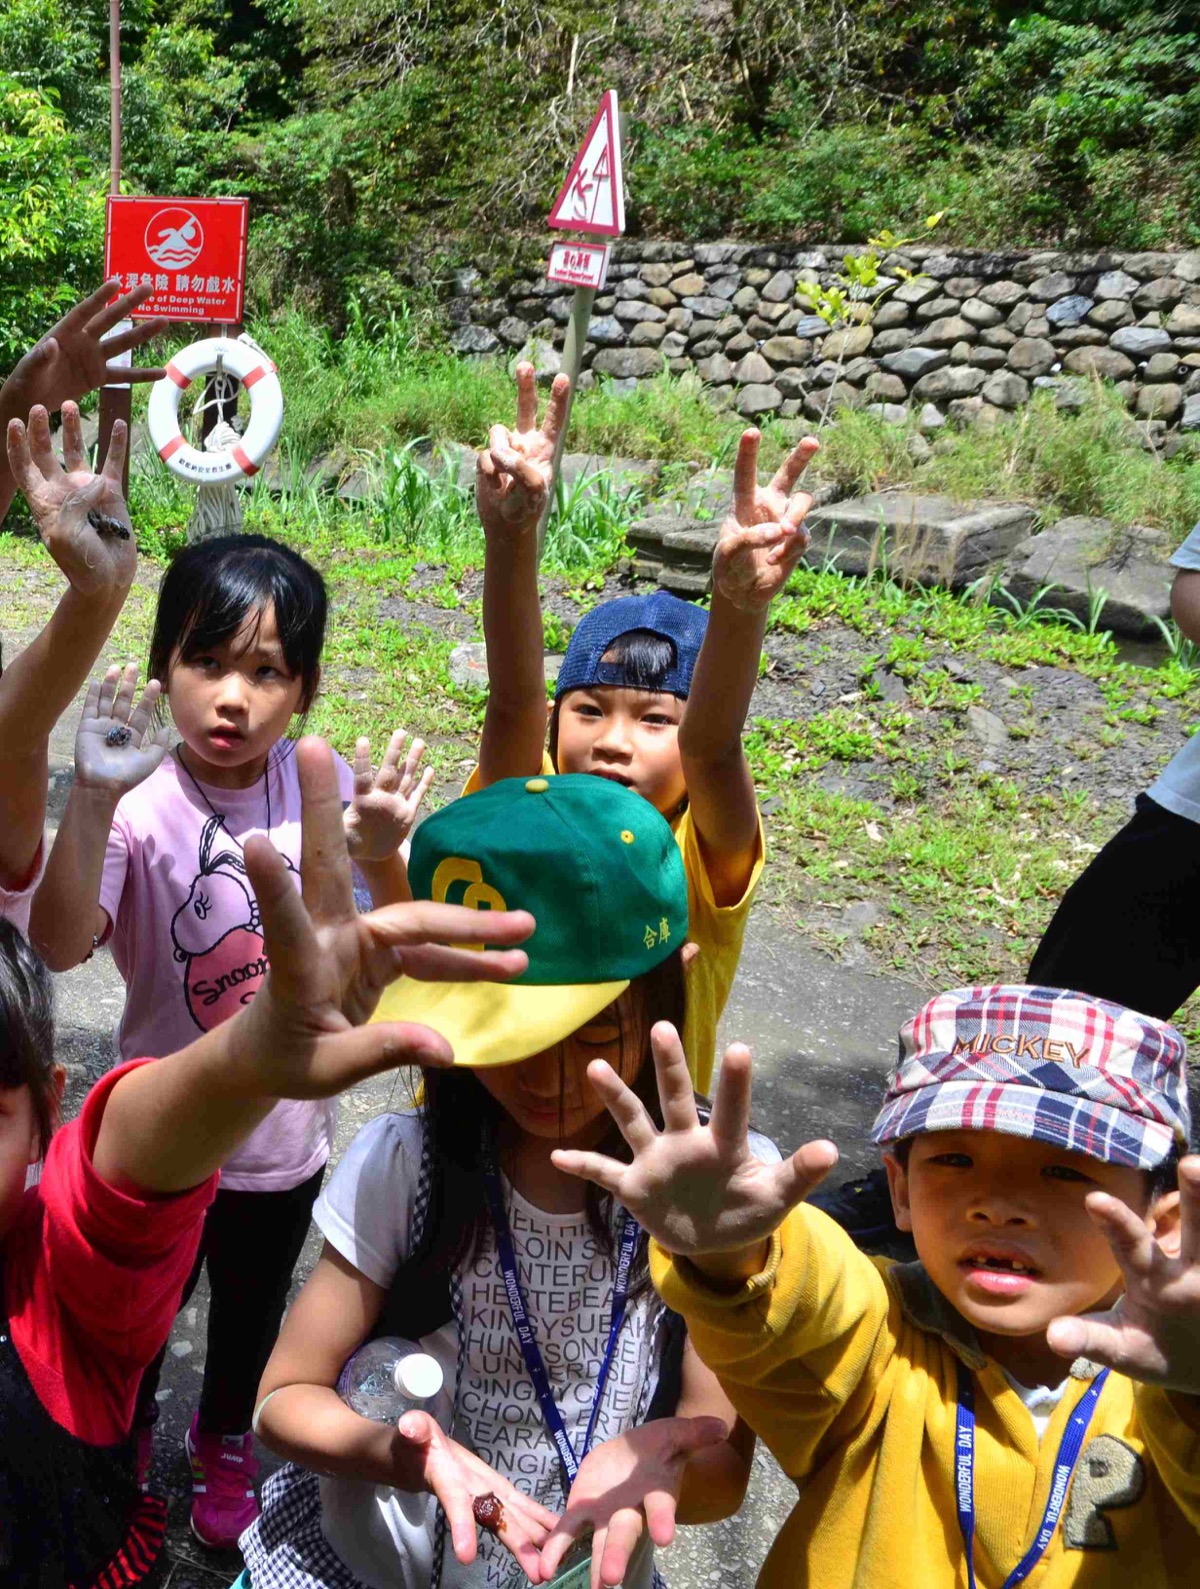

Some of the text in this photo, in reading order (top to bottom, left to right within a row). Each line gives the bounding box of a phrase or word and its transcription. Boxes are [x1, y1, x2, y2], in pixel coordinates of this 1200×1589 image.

[153, 304, 205, 316] Swimming
[155, 295, 168, 303] of
[169, 295, 195, 305] Deep
[197, 296, 227, 306] Water
[643, 917, 671, 949] 合庫
[951, 1032, 1090, 1069] MICKEY
[616, 1241, 634, 1293] WONDERFUL
[504, 1269, 534, 1345] WONDERFUL DAY
[554, 1429, 578, 1478] WONDERFUL
[957, 1426, 973, 1513] WONDERFUL DAY
[1037, 1464, 1071, 1550] WONDERFUL DAY
